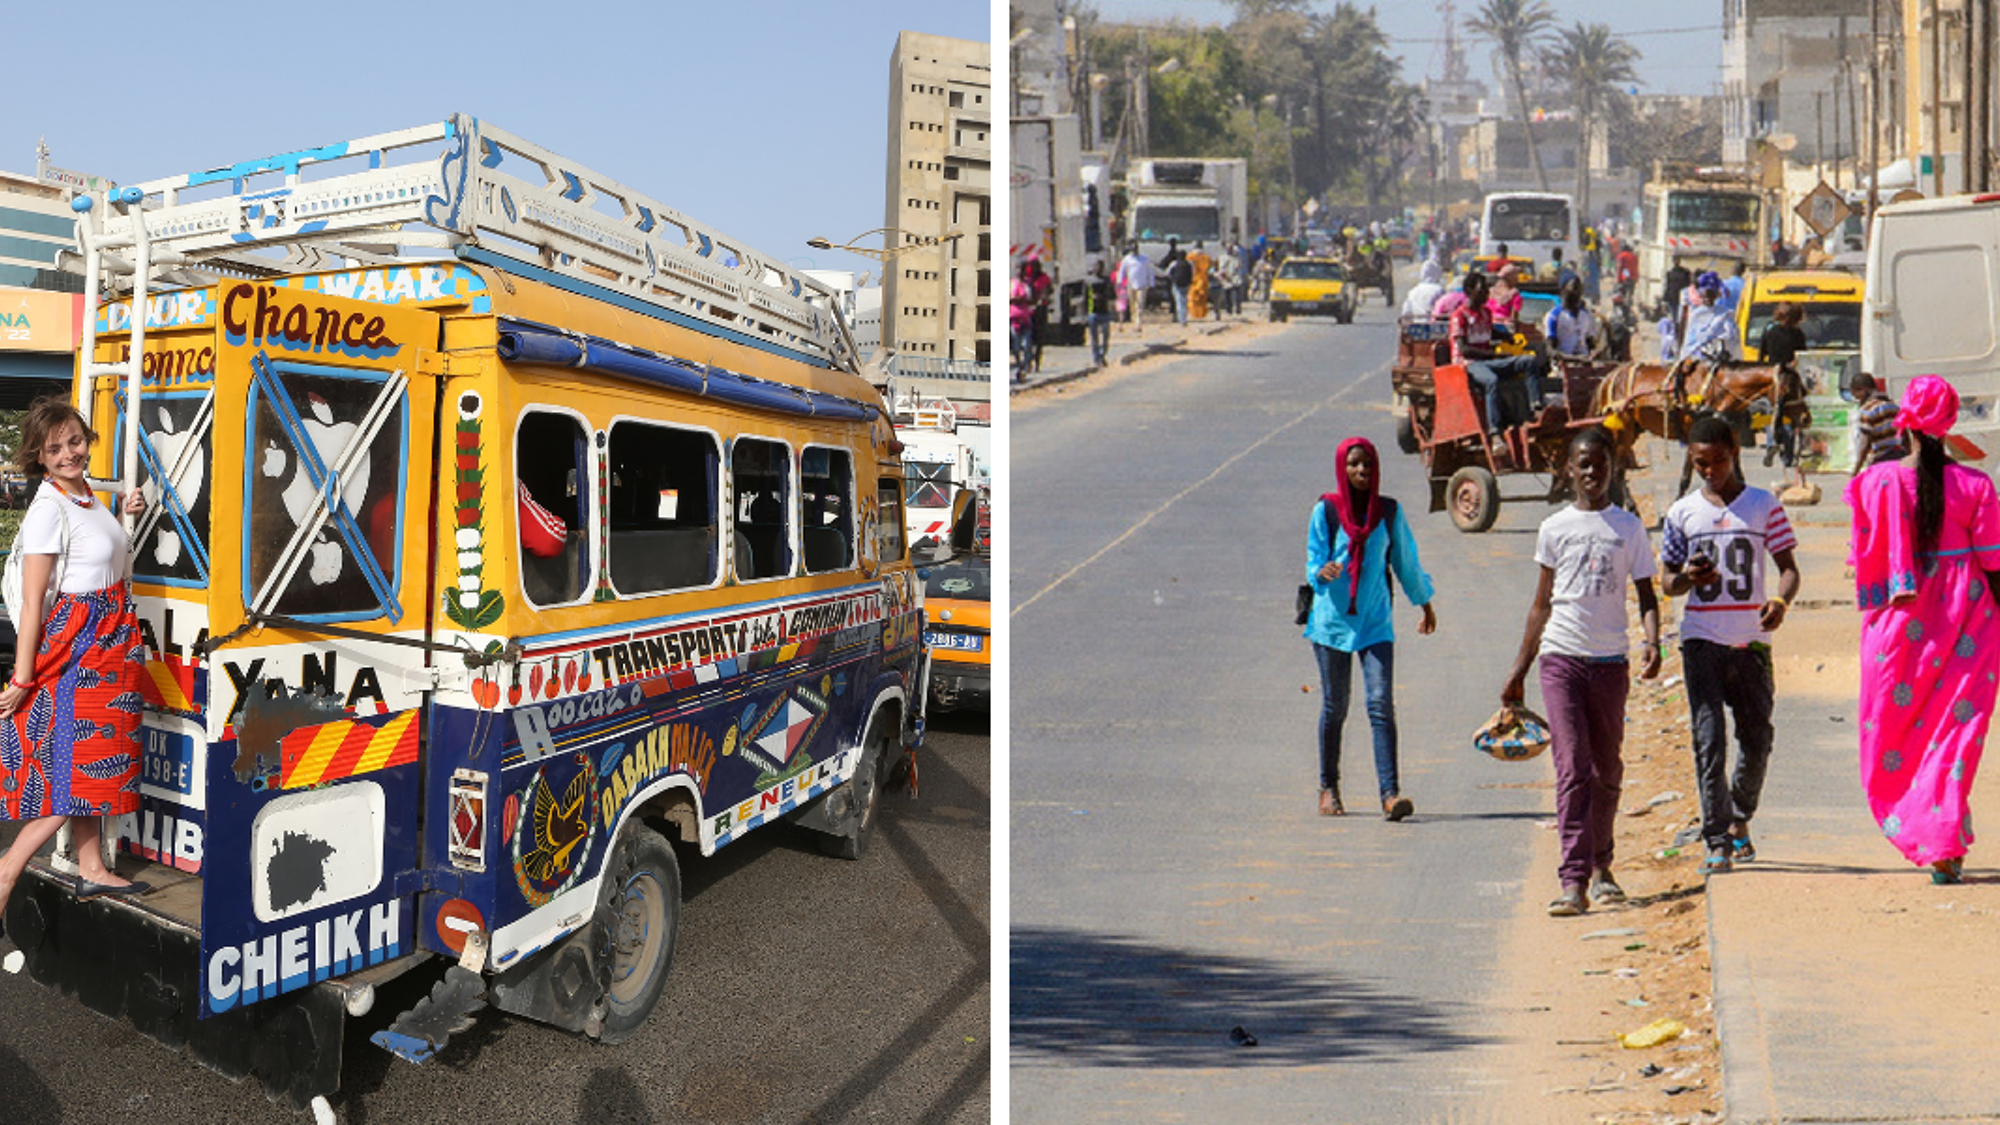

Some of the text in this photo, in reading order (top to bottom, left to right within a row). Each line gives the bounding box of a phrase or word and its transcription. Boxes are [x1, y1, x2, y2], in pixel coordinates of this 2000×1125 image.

[223, 283, 405, 352] Chance
[322, 267, 447, 303] WAAR
[149, 730, 168, 757] DK
[714, 751, 849, 835] RENEULT
[208, 898, 400, 1006] CHEIKH
